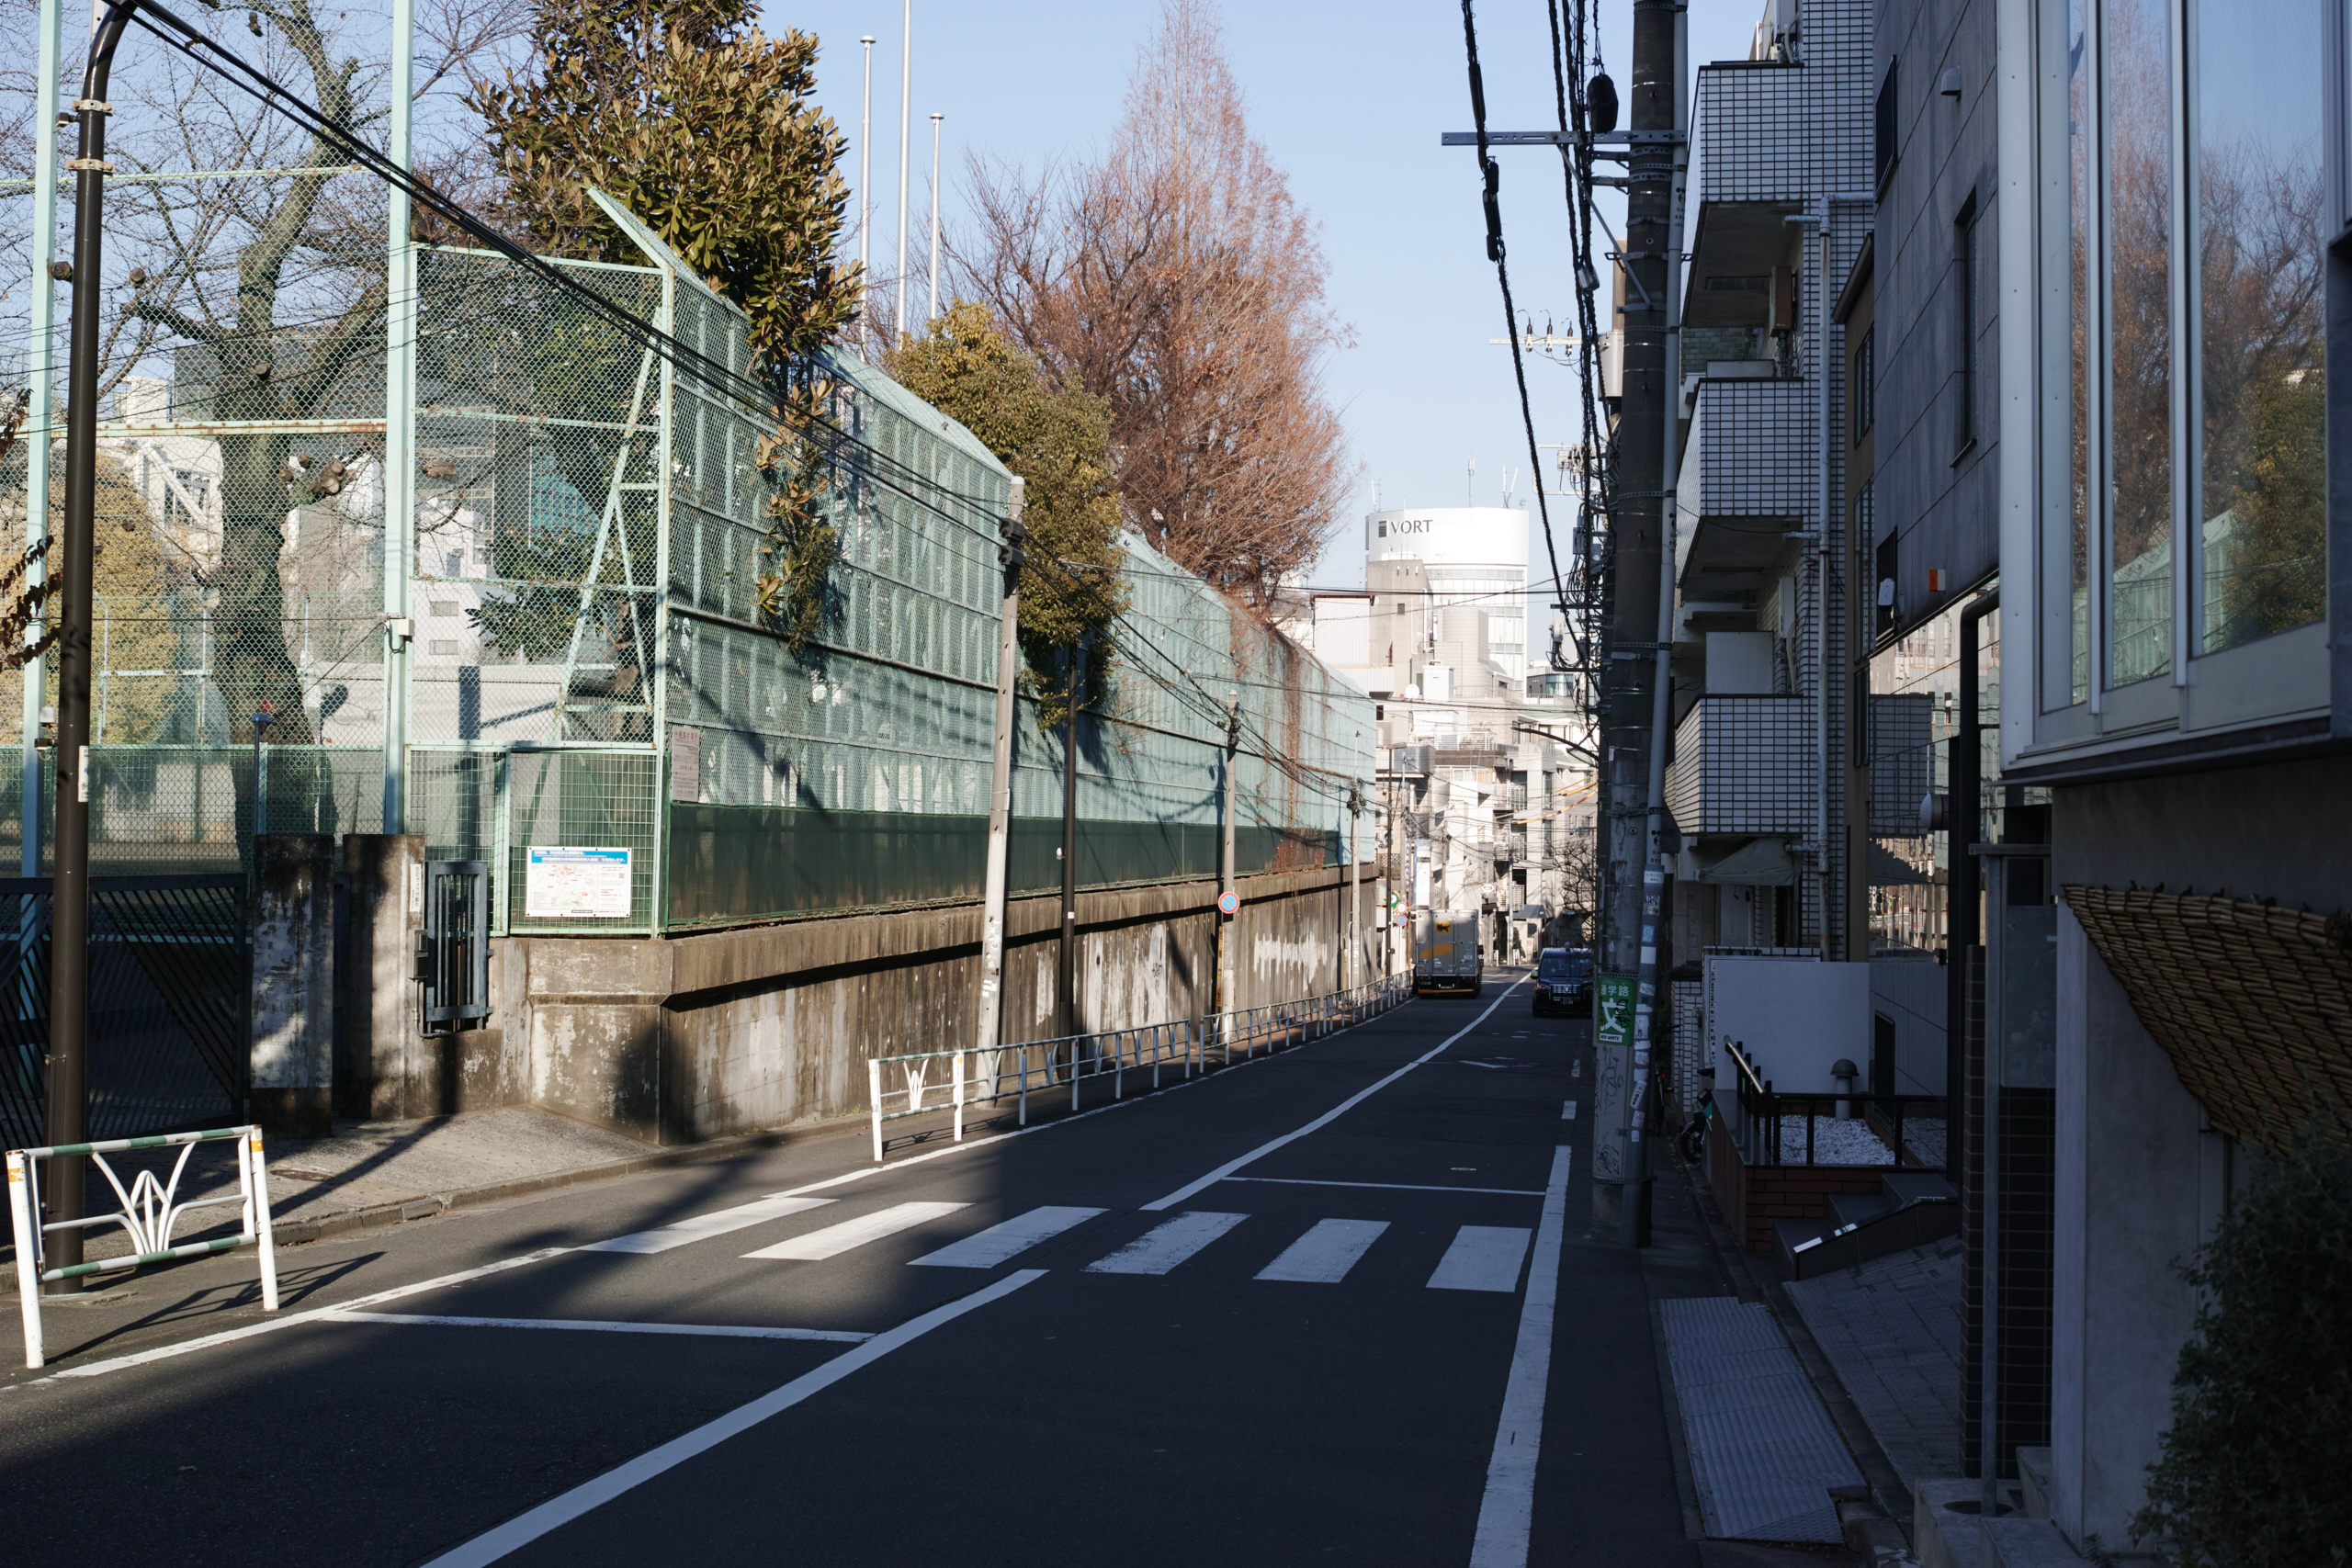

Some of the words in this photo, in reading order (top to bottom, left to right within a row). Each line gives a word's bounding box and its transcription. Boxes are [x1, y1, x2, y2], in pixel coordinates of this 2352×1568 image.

[1391, 519, 1433, 535] VORT
[1600, 984, 1629, 997] 通学路
